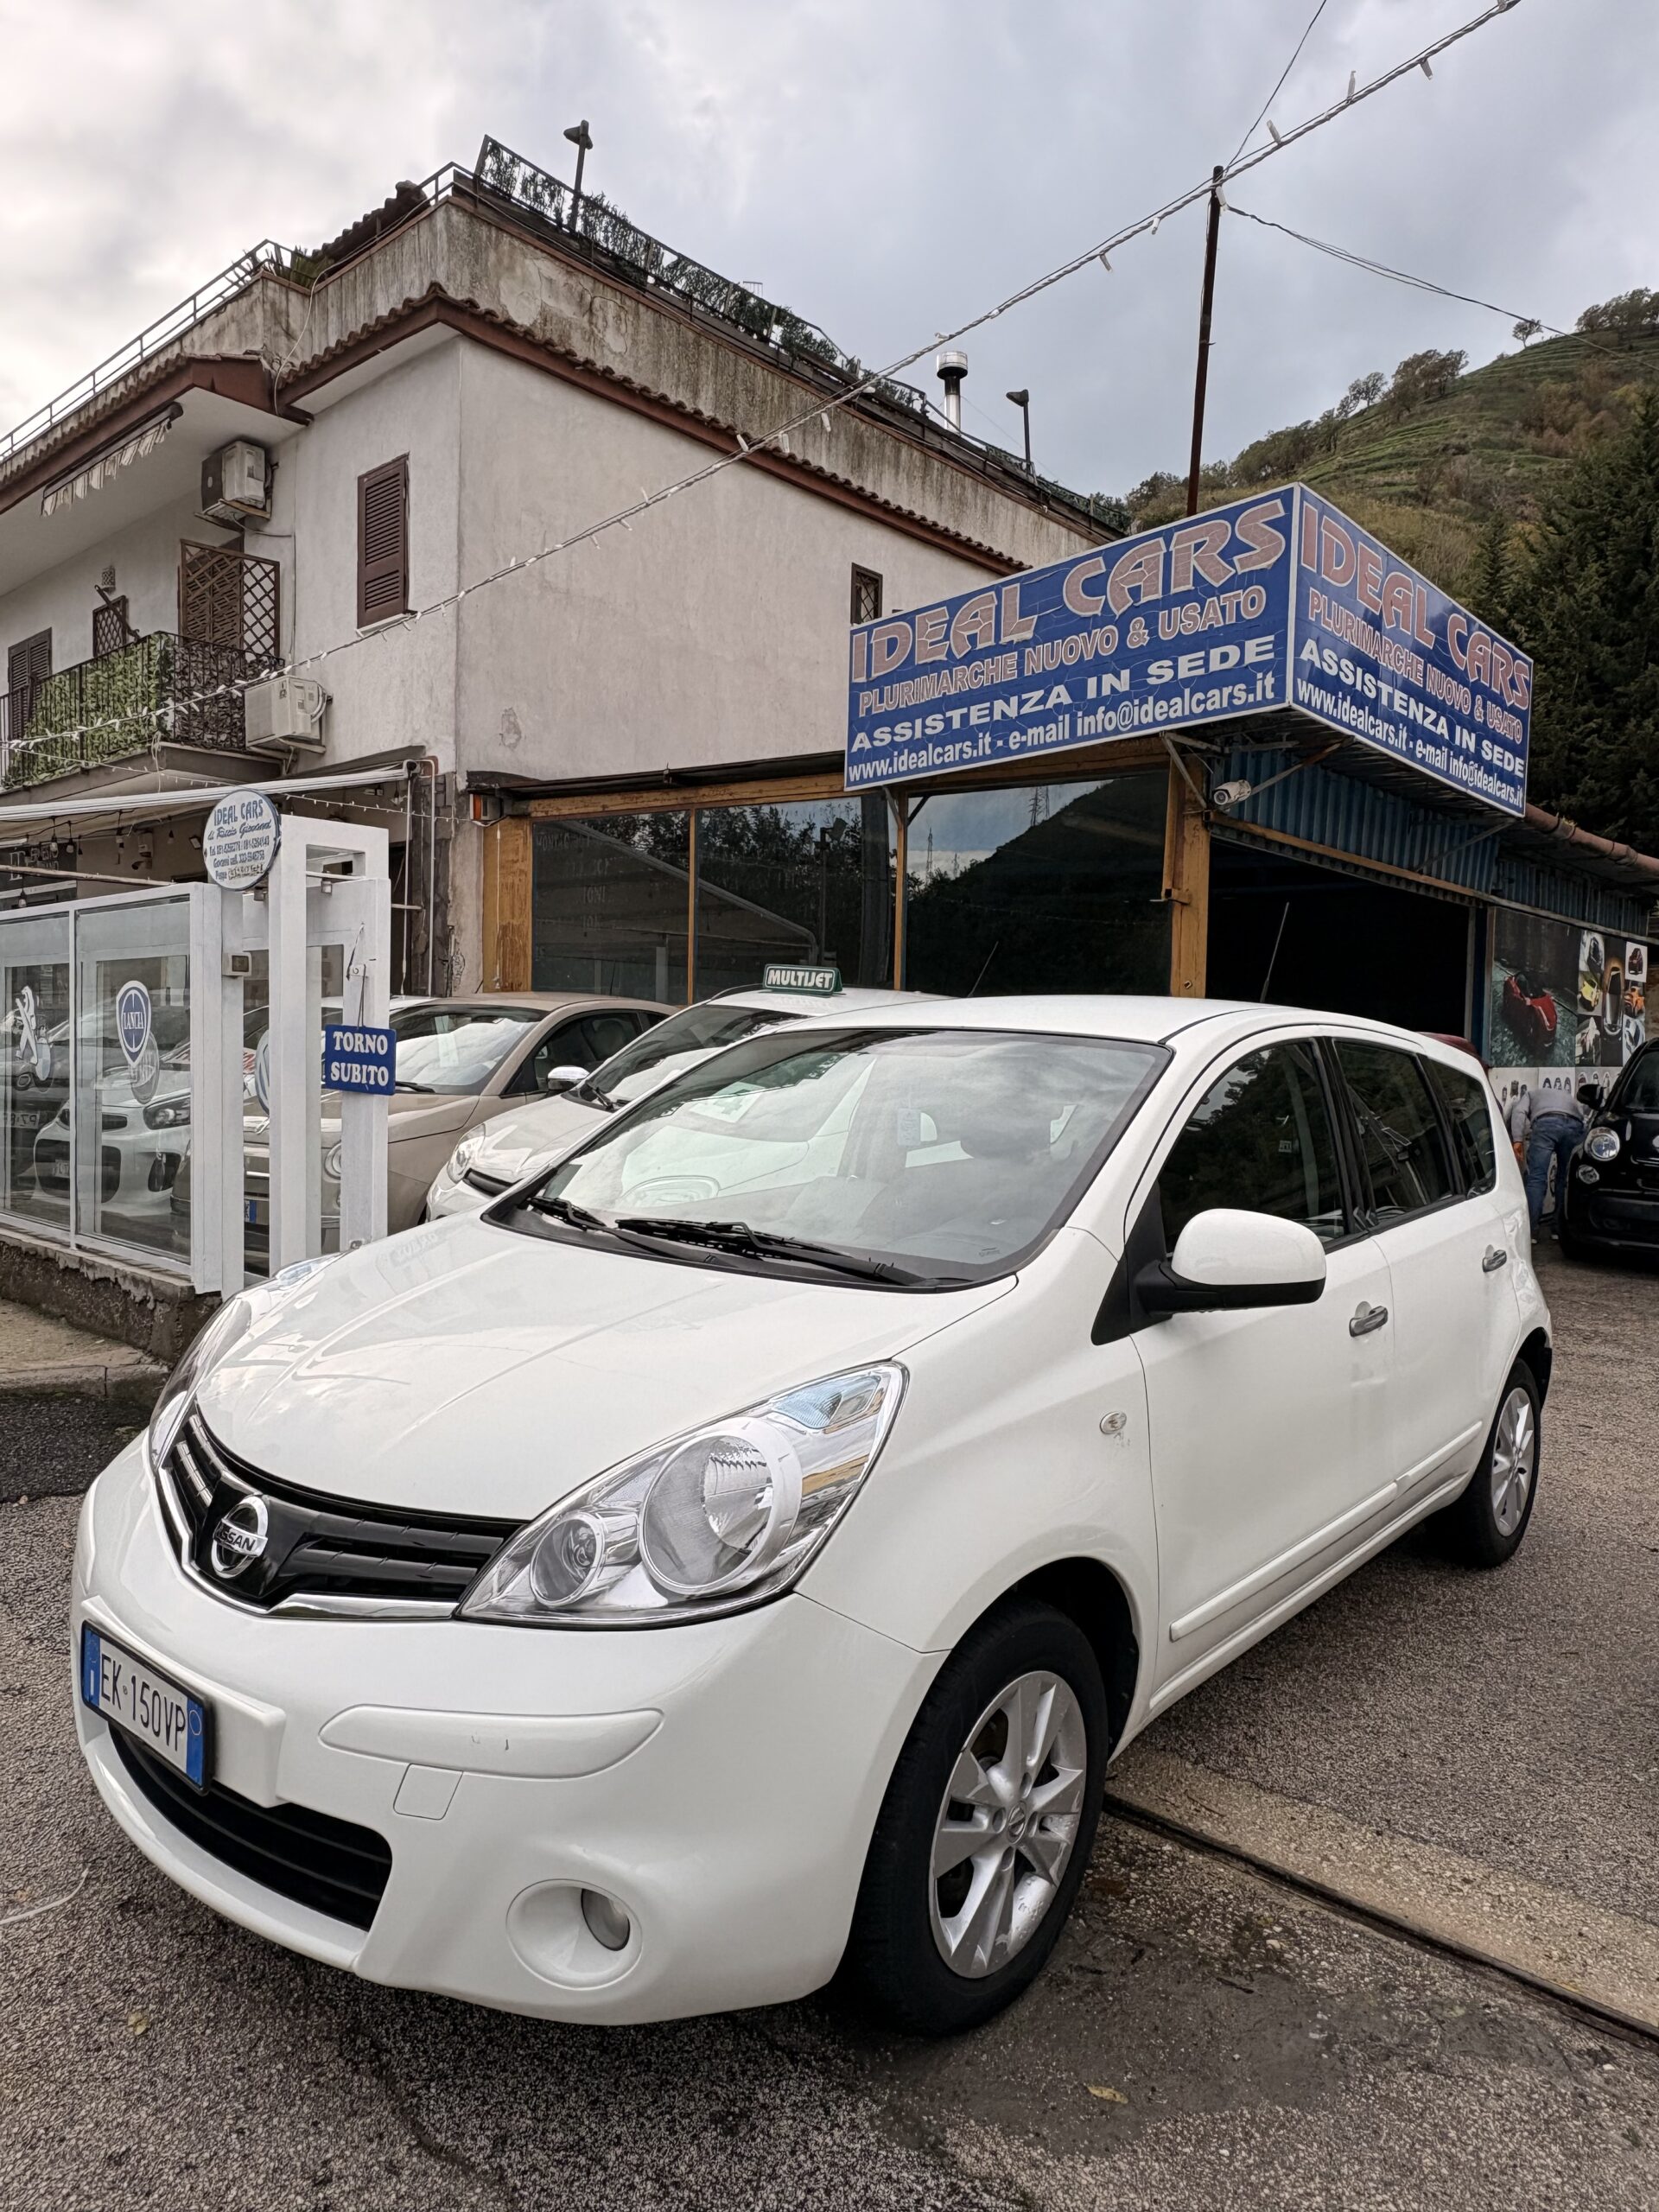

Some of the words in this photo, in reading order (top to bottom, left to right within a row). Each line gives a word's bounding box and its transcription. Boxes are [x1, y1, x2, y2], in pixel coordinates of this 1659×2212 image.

[852, 583, 1038, 683] IDEAL
[1063, 499, 1285, 618] CARS
[1300, 500, 1435, 649] IDEAL
[1447, 613, 1529, 710] CARS
[851, 684, 1073, 753] ASSISTENZA
[1087, 669, 1130, 699] IN
[1147, 635, 1274, 684] SEDE
[859, 651, 1018, 717] PLURIMARCHE
[1025, 625, 1119, 674] NUOVO
[1127, 617, 1150, 648] &
[1159, 586, 1266, 640] USATO
[1300, 639, 1449, 740] ASSISTENZA
[1455, 725, 1476, 753] IN
[1481, 740, 1524, 778] SEDE
[1308, 588, 1423, 687] PLURIMARCHE
[1427, 664, 1471, 715] NUOVO
[1474, 695, 1484, 723] &
[1487, 701, 1522, 744] USATO
[849, 732, 991, 782] www.idealcars.it
[1009, 714, 1070, 749] e-mail
[1077, 671, 1274, 736] info@idealcars.it
[1297, 678, 1408, 751] www.idealcars.it
[1416, 739, 1447, 772] e-mail
[1450, 751, 1523, 808] info@idealcars.it
[214, 804, 238, 826] IDEAL
[241, 799, 264, 820] CARS
[767, 969, 832, 988] MULTIJET
[331, 1062, 389, 1086] SUBITO
[333, 1032, 388, 1055] TORNO
[215, 1522, 256, 1552] SSAN
[101, 1654, 122, 1710] EK
[131, 1675, 186, 1751] 150VP
